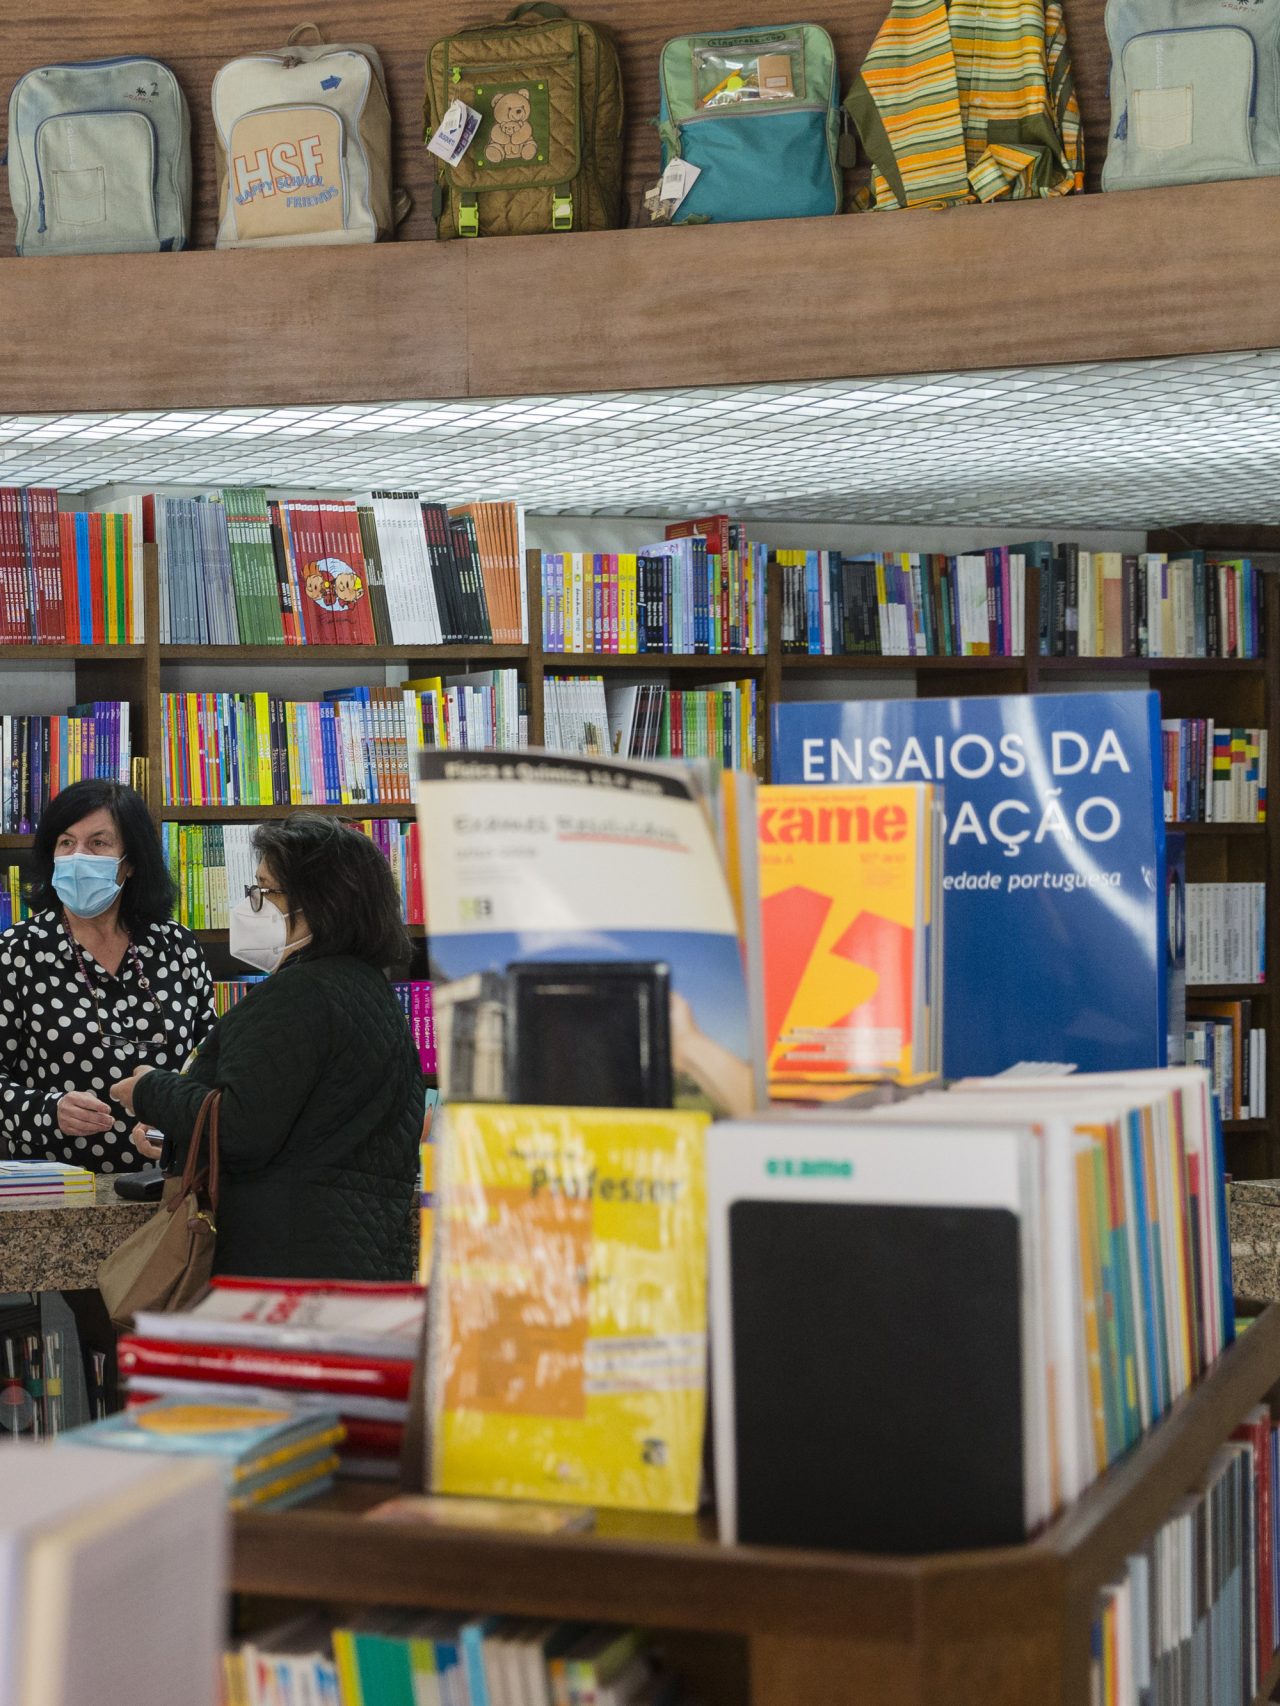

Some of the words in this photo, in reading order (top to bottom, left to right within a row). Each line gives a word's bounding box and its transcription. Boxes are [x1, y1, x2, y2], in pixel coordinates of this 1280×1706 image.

[233, 134, 323, 205] HSF
[235, 180, 273, 205] HAPPY
[276, 174, 325, 190] SCHOOL
[285, 186, 339, 208] FRIENDS
[803, 733, 1026, 782] ENSAIOS
[1052, 730, 1131, 775] DA
[1007, 868, 1121, 893] portuguesa
